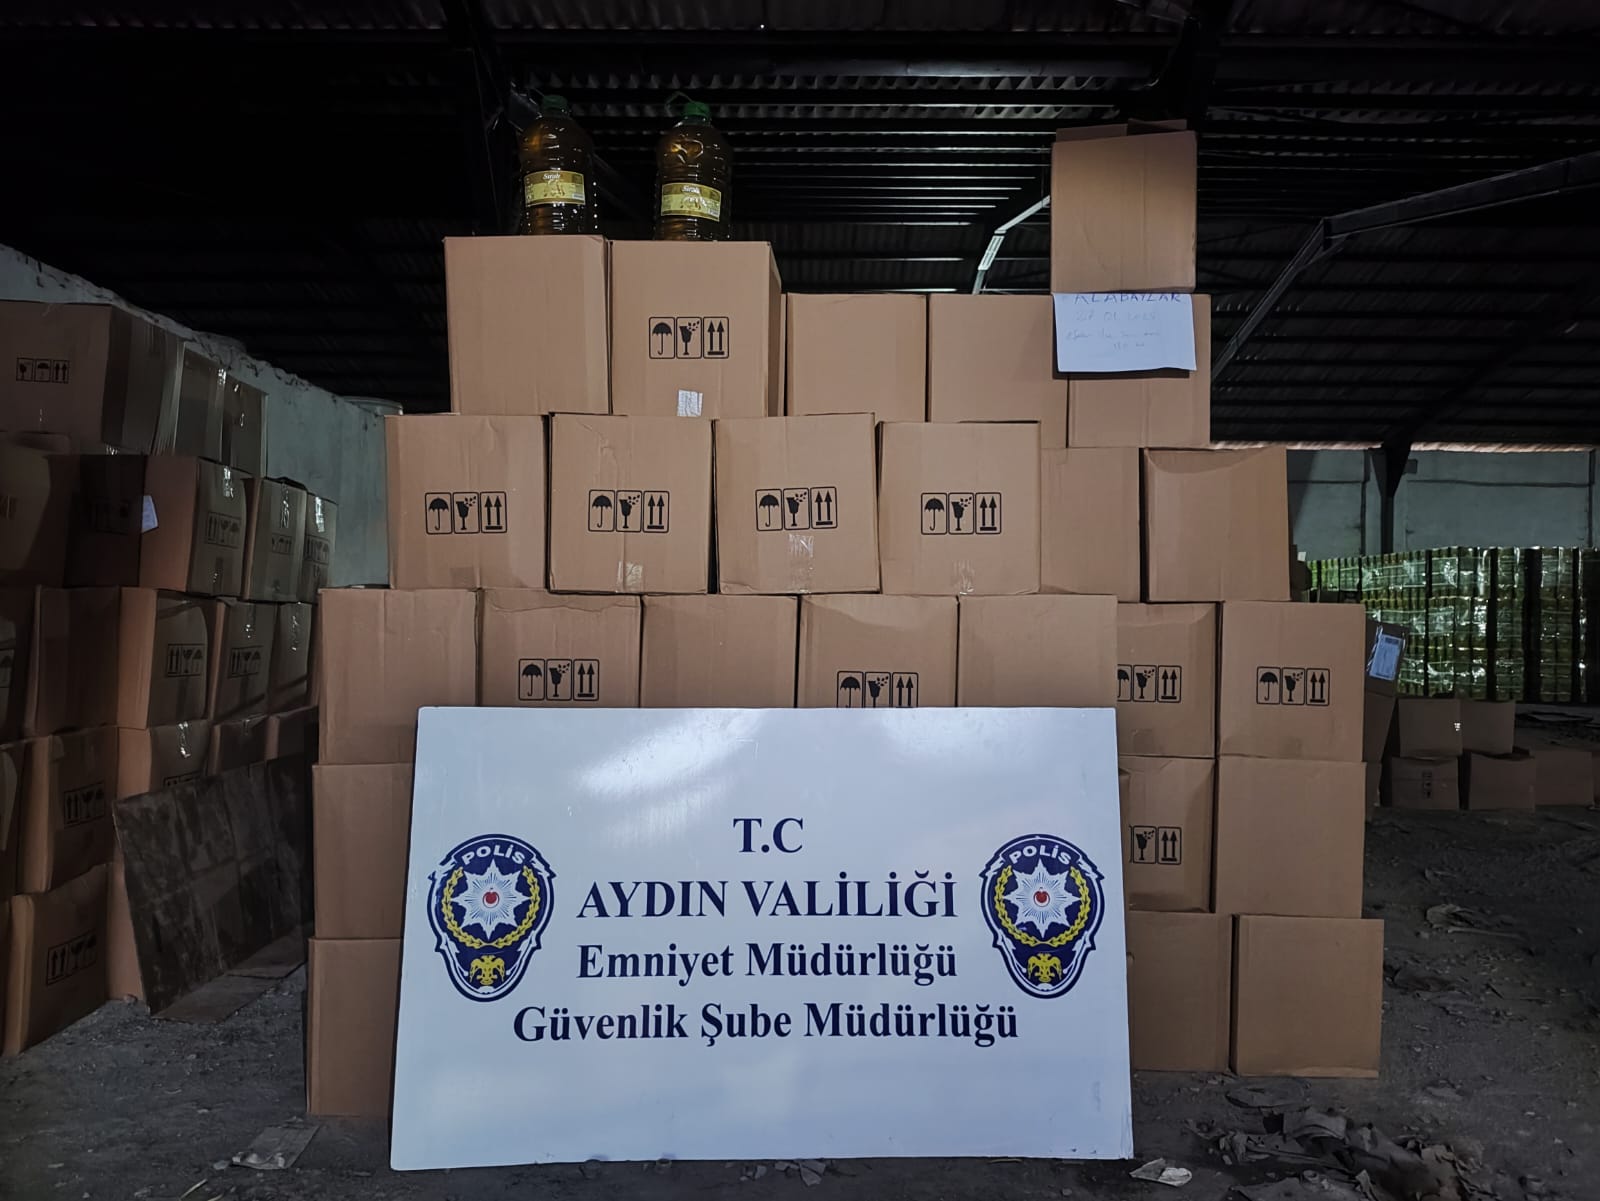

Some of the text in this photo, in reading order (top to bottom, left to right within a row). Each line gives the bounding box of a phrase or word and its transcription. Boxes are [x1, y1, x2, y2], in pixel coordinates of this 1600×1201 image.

[461, 844, 526, 866] POLİS
[732, 817, 804, 854] T.C
[1008, 844, 1072, 866] POLİS
[576, 870, 958, 919] AYDIN VALİLİĞİ
[576, 942, 958, 987] Emniyet Müdürlüğü
[513, 1002, 1019, 1048] Güvenlik Şube Müdürlüğü
